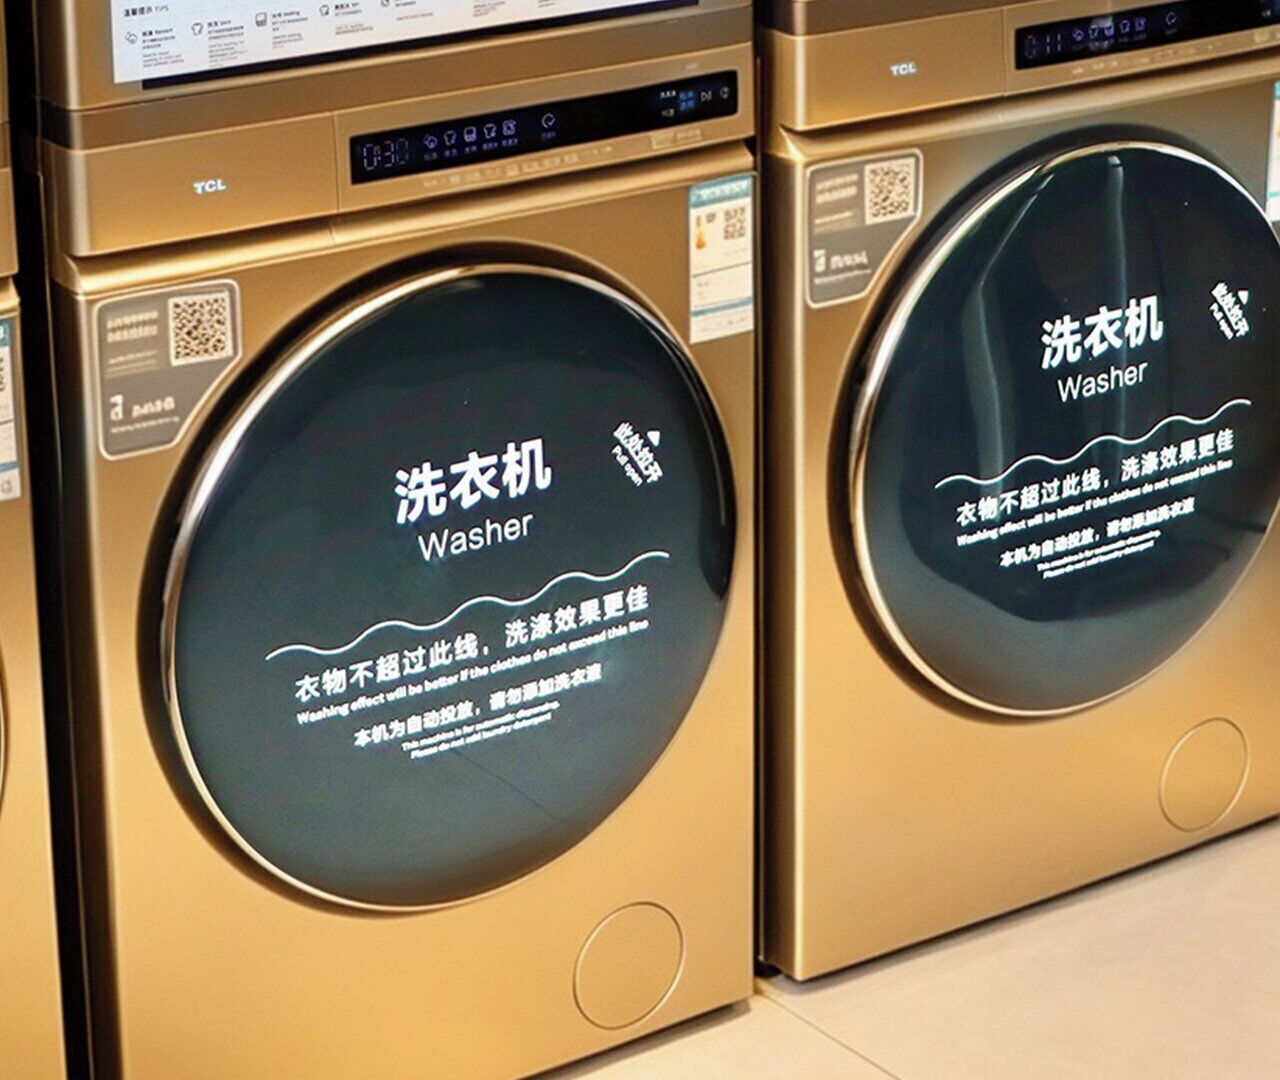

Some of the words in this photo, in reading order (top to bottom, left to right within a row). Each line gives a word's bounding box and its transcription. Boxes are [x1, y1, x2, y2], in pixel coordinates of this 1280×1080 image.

[891, 62, 917, 76] TCL
[193, 179, 226, 195] TCL
[1040, 294, 1165, 370] 洗衣机
[1057, 360, 1148, 403] Washer
[394, 437, 552, 525] 洗衣机
[418, 512, 534, 562] Washer
